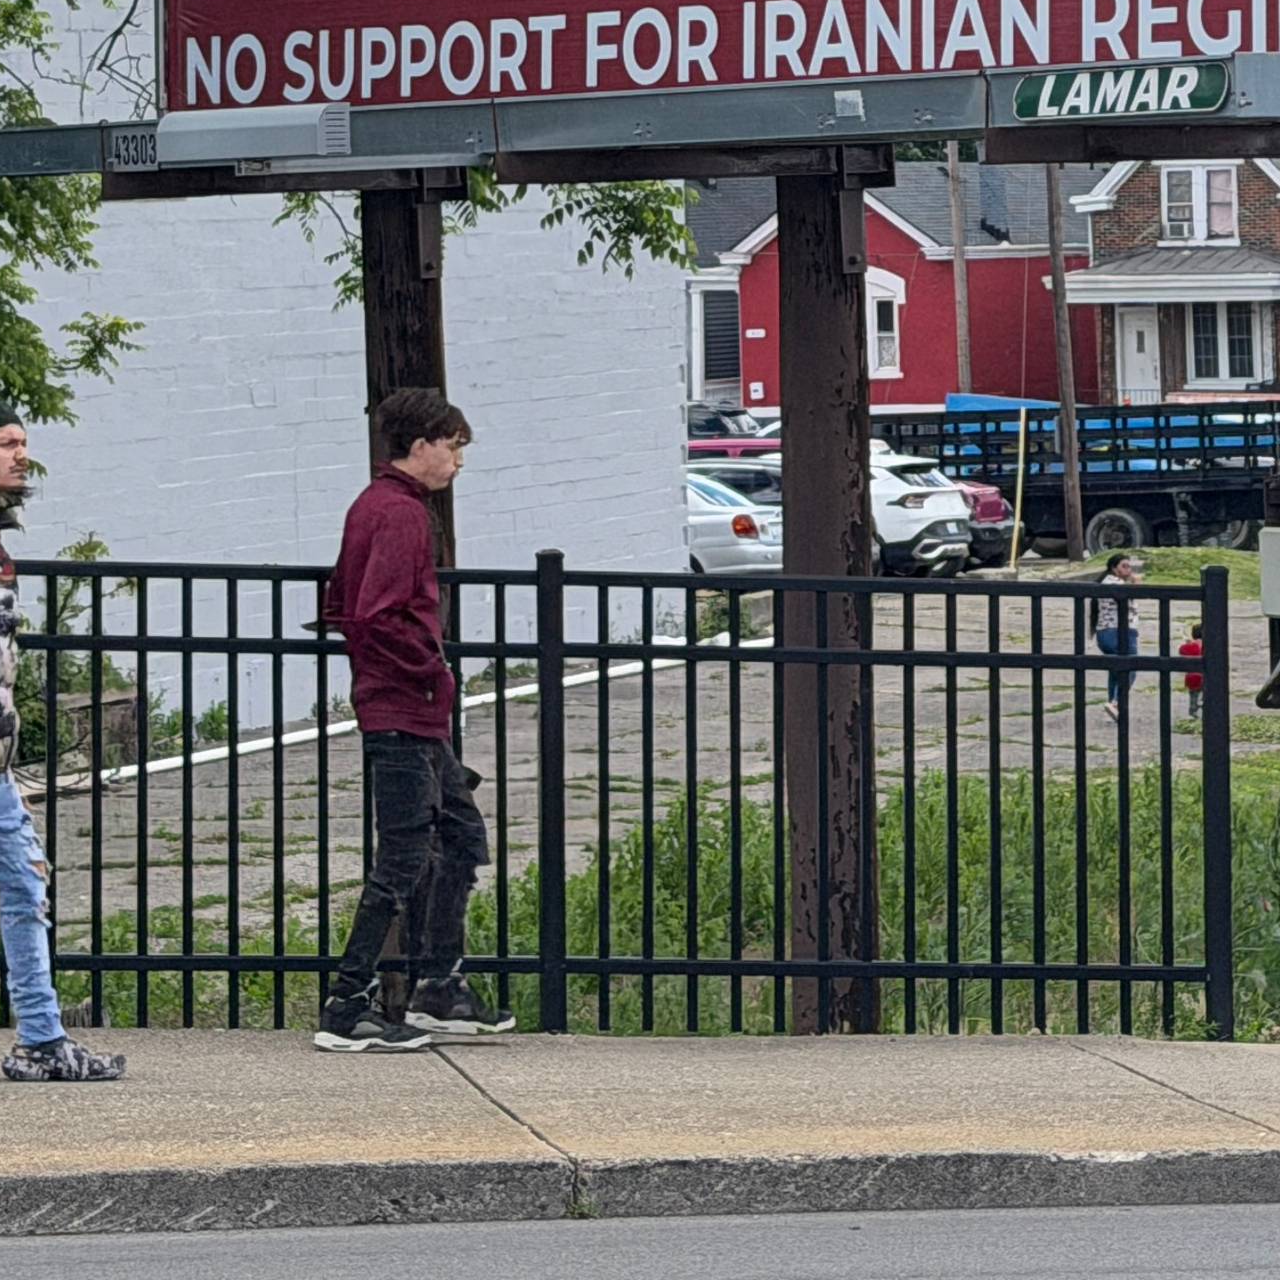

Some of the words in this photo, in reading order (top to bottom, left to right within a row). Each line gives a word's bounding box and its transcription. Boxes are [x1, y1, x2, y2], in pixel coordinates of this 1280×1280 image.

[184, 33, 267, 105] NO
[283, 14, 567, 103] SUPPORT
[586, 5, 718, 88] FOR
[1037, 66, 1199, 117] LAMAR
[114, 134, 157, 166] 43303
